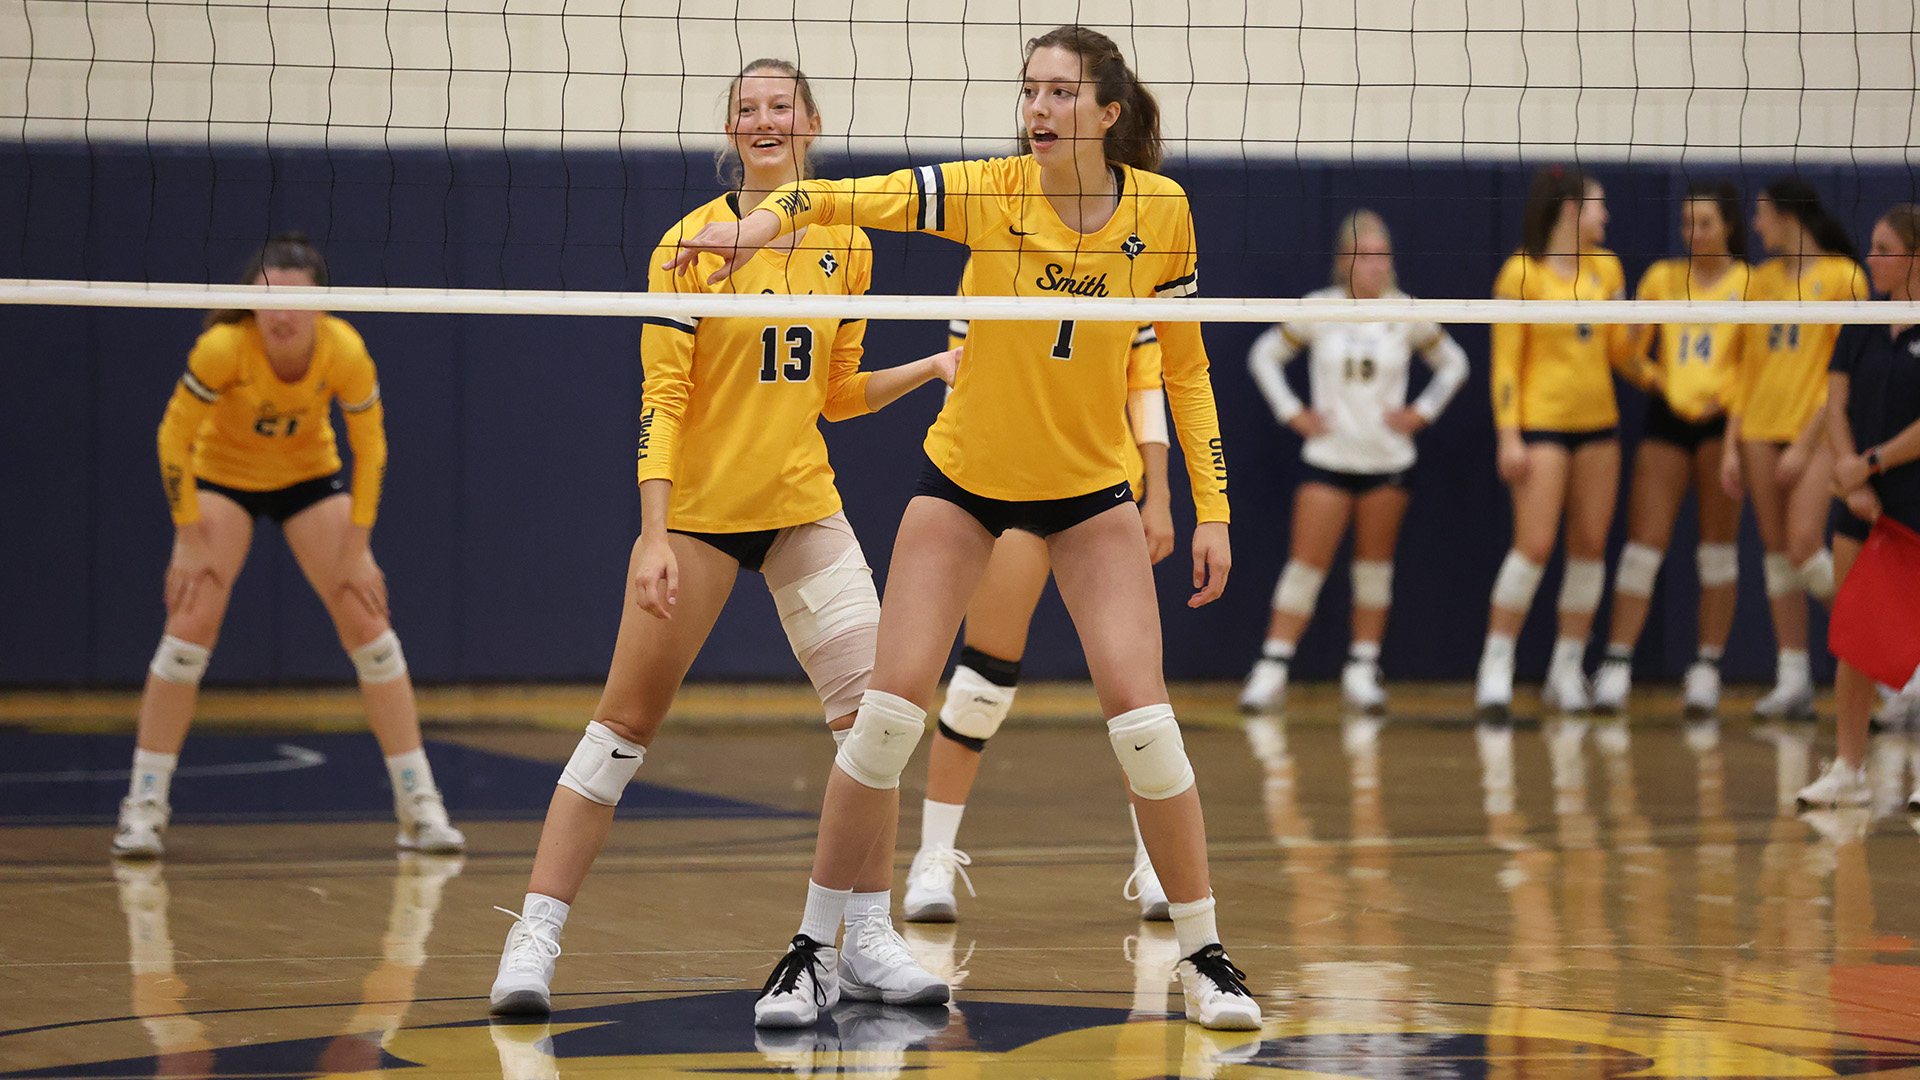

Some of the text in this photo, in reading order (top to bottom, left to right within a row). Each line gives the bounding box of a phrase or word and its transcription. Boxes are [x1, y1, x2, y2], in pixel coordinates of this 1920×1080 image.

[775, 188, 812, 219] FAMILY
[1036, 263, 1109, 298] Smith
[758, 324, 815, 383] 13
[1050, 319, 1077, 361] 1
[637, 408, 655, 460] FAMIL
